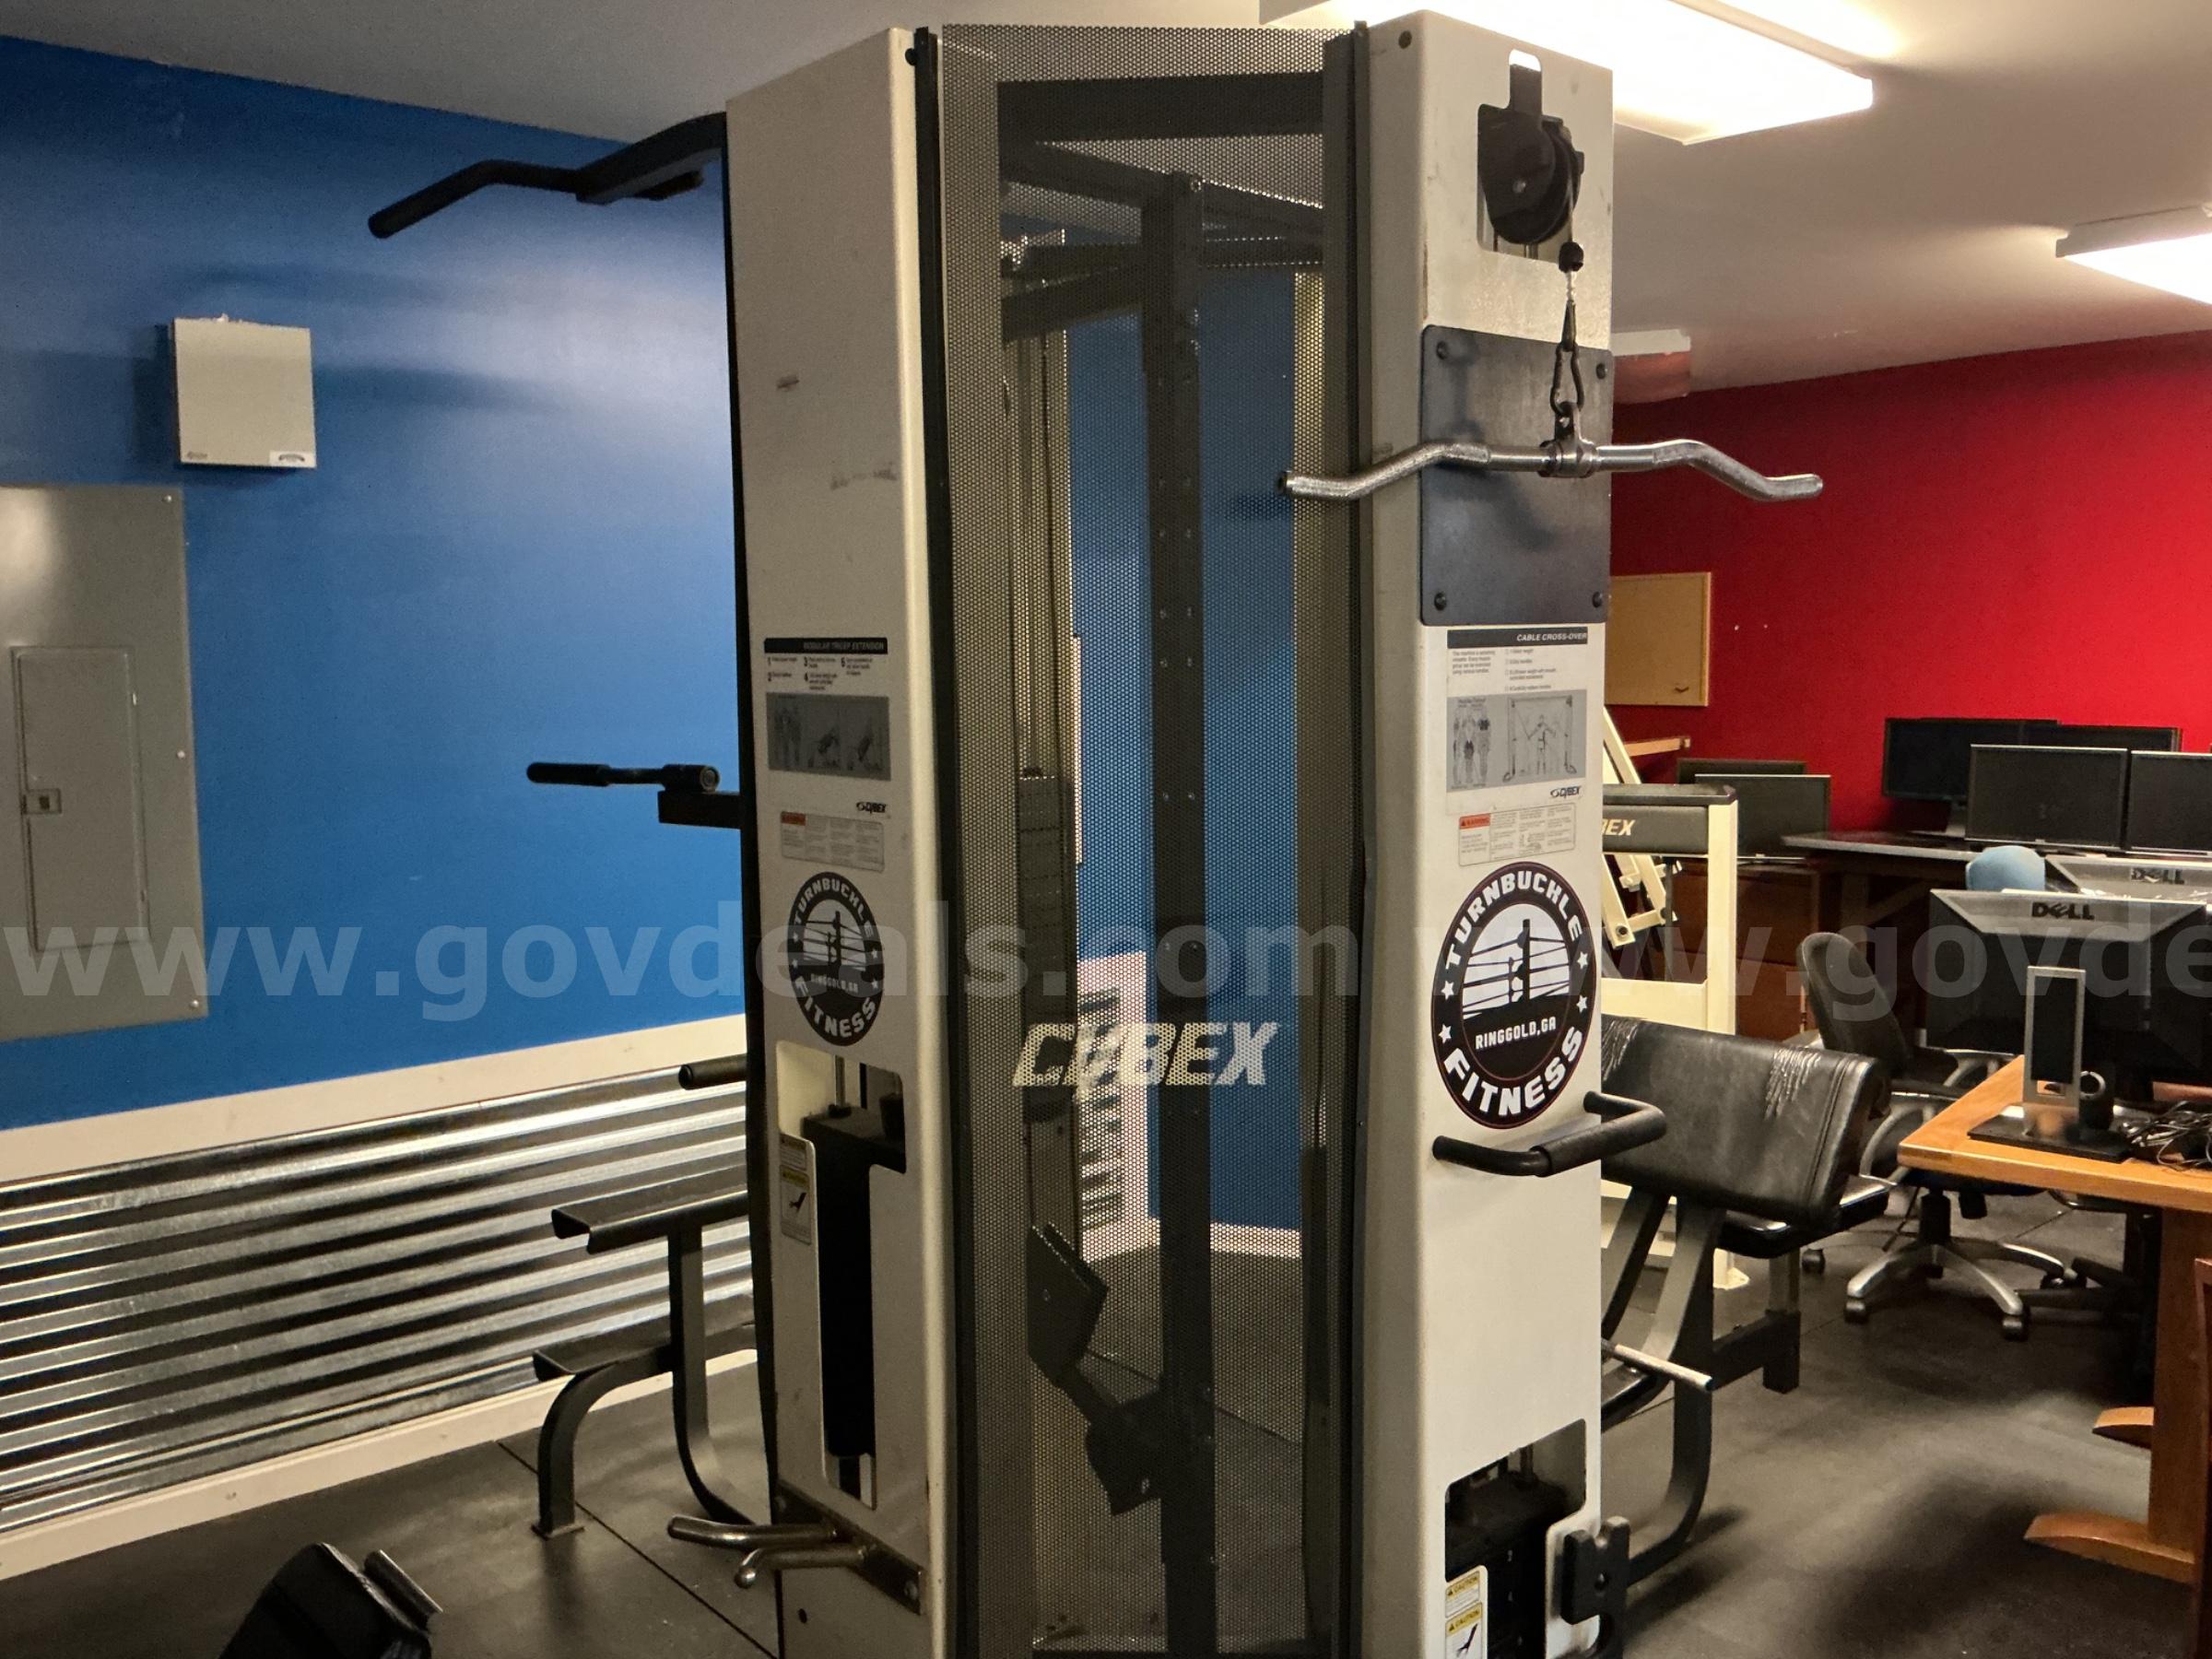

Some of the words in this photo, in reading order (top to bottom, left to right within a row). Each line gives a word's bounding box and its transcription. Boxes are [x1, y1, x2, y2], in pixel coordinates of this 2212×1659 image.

[1516, 632, 1540, 641] CABLE
[1542, 631, 1587, 641] CROSS-OVER
[2133, 867, 2185, 885] DELL
[794, 877, 874, 938] TURNBUCKLE
[1445, 870, 1583, 970] TURNBUCKLE
[2031, 900, 2095, 921] DELL
[794, 975, 876, 1039] FITNESS
[1014, 1021, 1279, 1097] CYBEX
[1443, 1026, 1583, 1117] FITNESS
